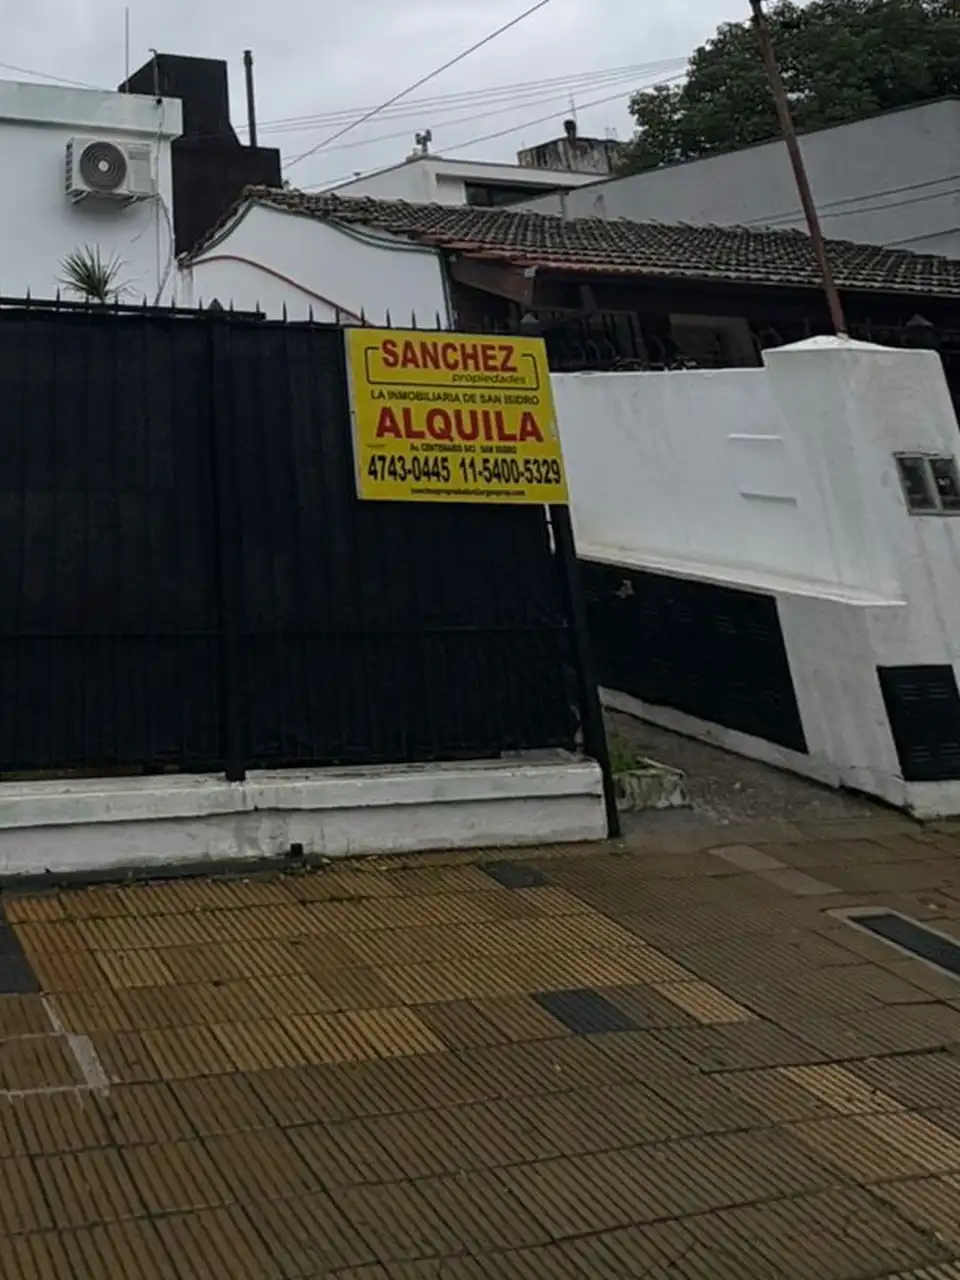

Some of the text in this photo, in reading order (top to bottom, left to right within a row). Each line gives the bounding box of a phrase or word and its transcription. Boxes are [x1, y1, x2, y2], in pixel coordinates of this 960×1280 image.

[381, 340, 518, 373] SANCHEZ
[452, 373, 526, 385] propiedades
[370, 389, 539, 405] LA INMOBILIARIA DE SAN ISIDRO
[376, 407, 544, 442] ALQUILA
[368, 454, 561, 484] 4743-0445 11-5400-5329
